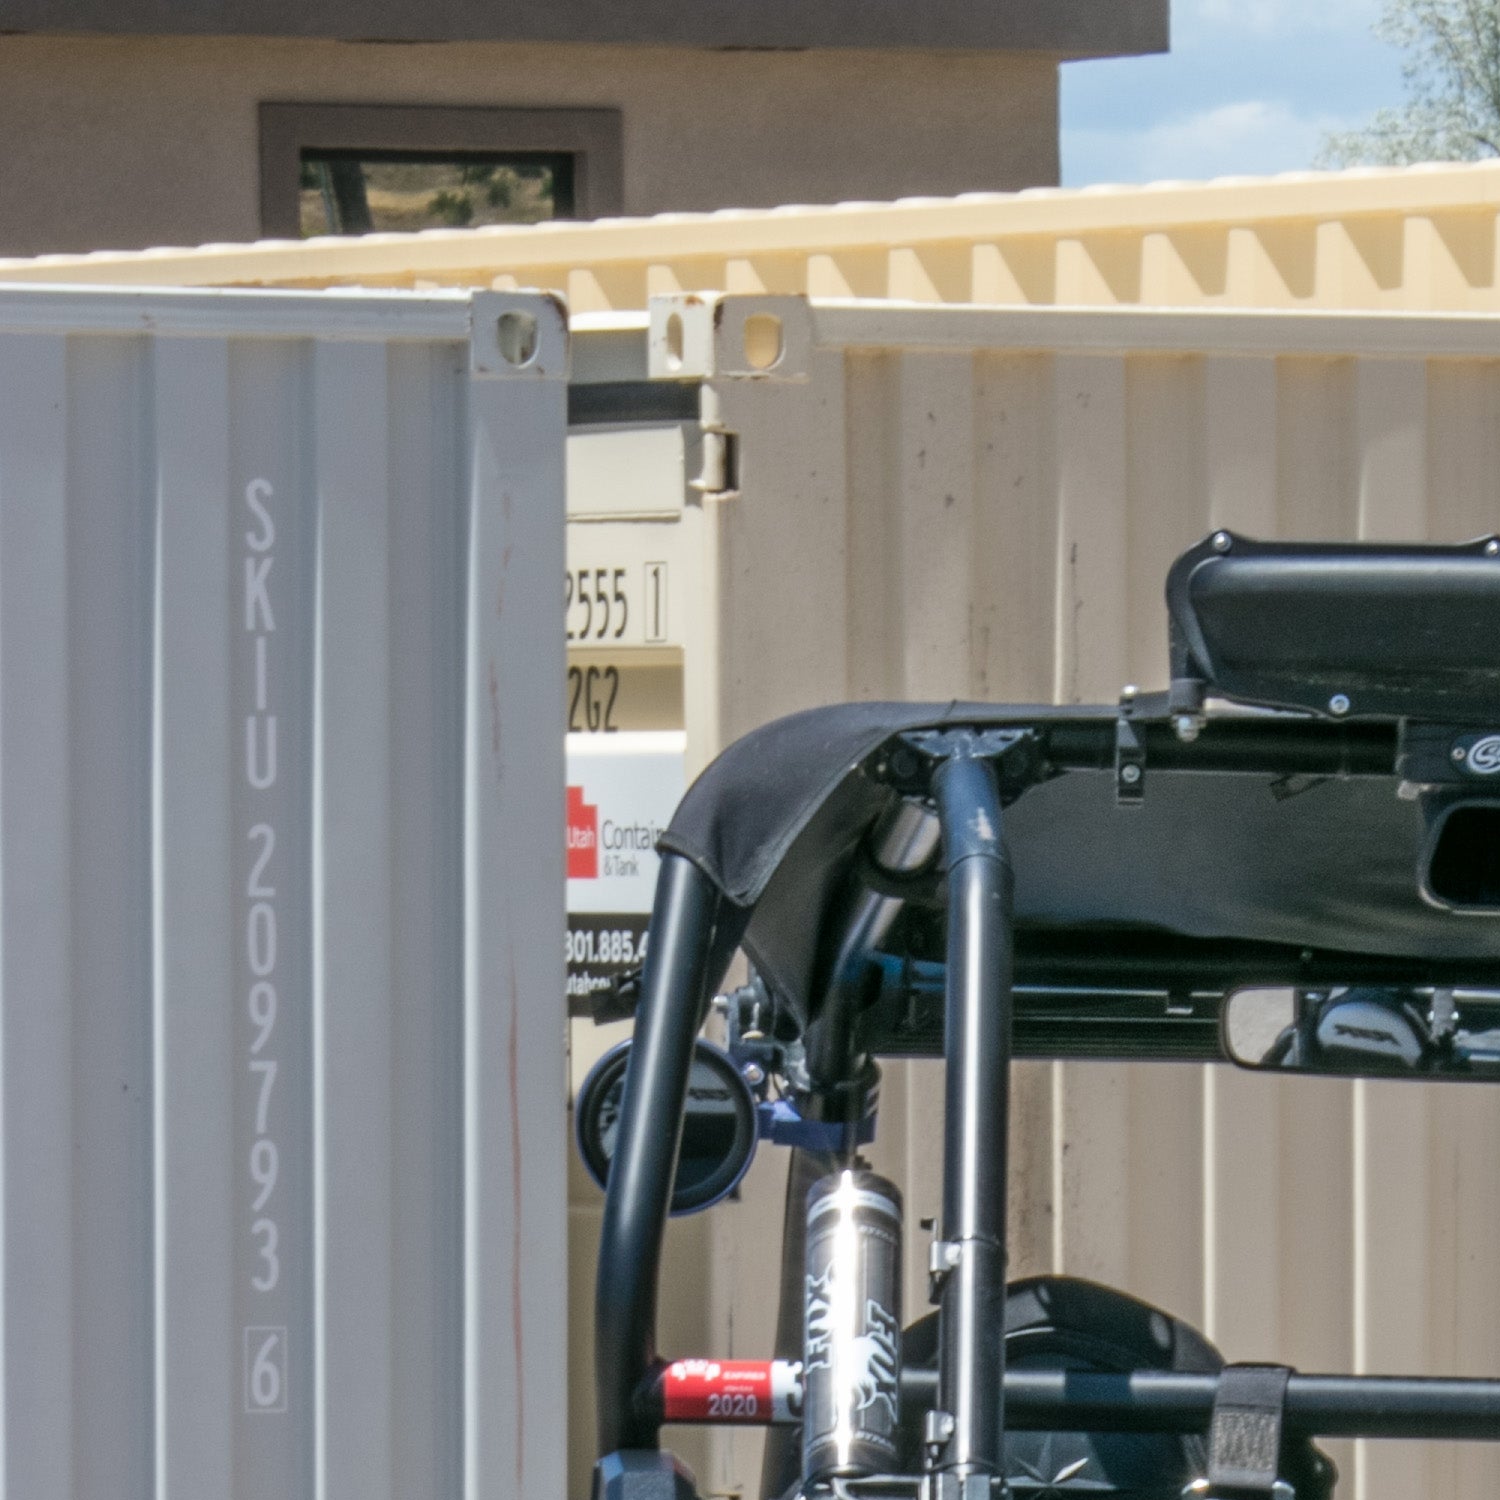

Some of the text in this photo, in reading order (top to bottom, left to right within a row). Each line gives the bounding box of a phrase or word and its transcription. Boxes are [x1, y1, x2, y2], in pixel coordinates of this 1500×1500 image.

[244, 478, 277, 790] SKIU
[246, 823, 280, 1293] 209793
[708, 1394, 758, 1416] 2020
